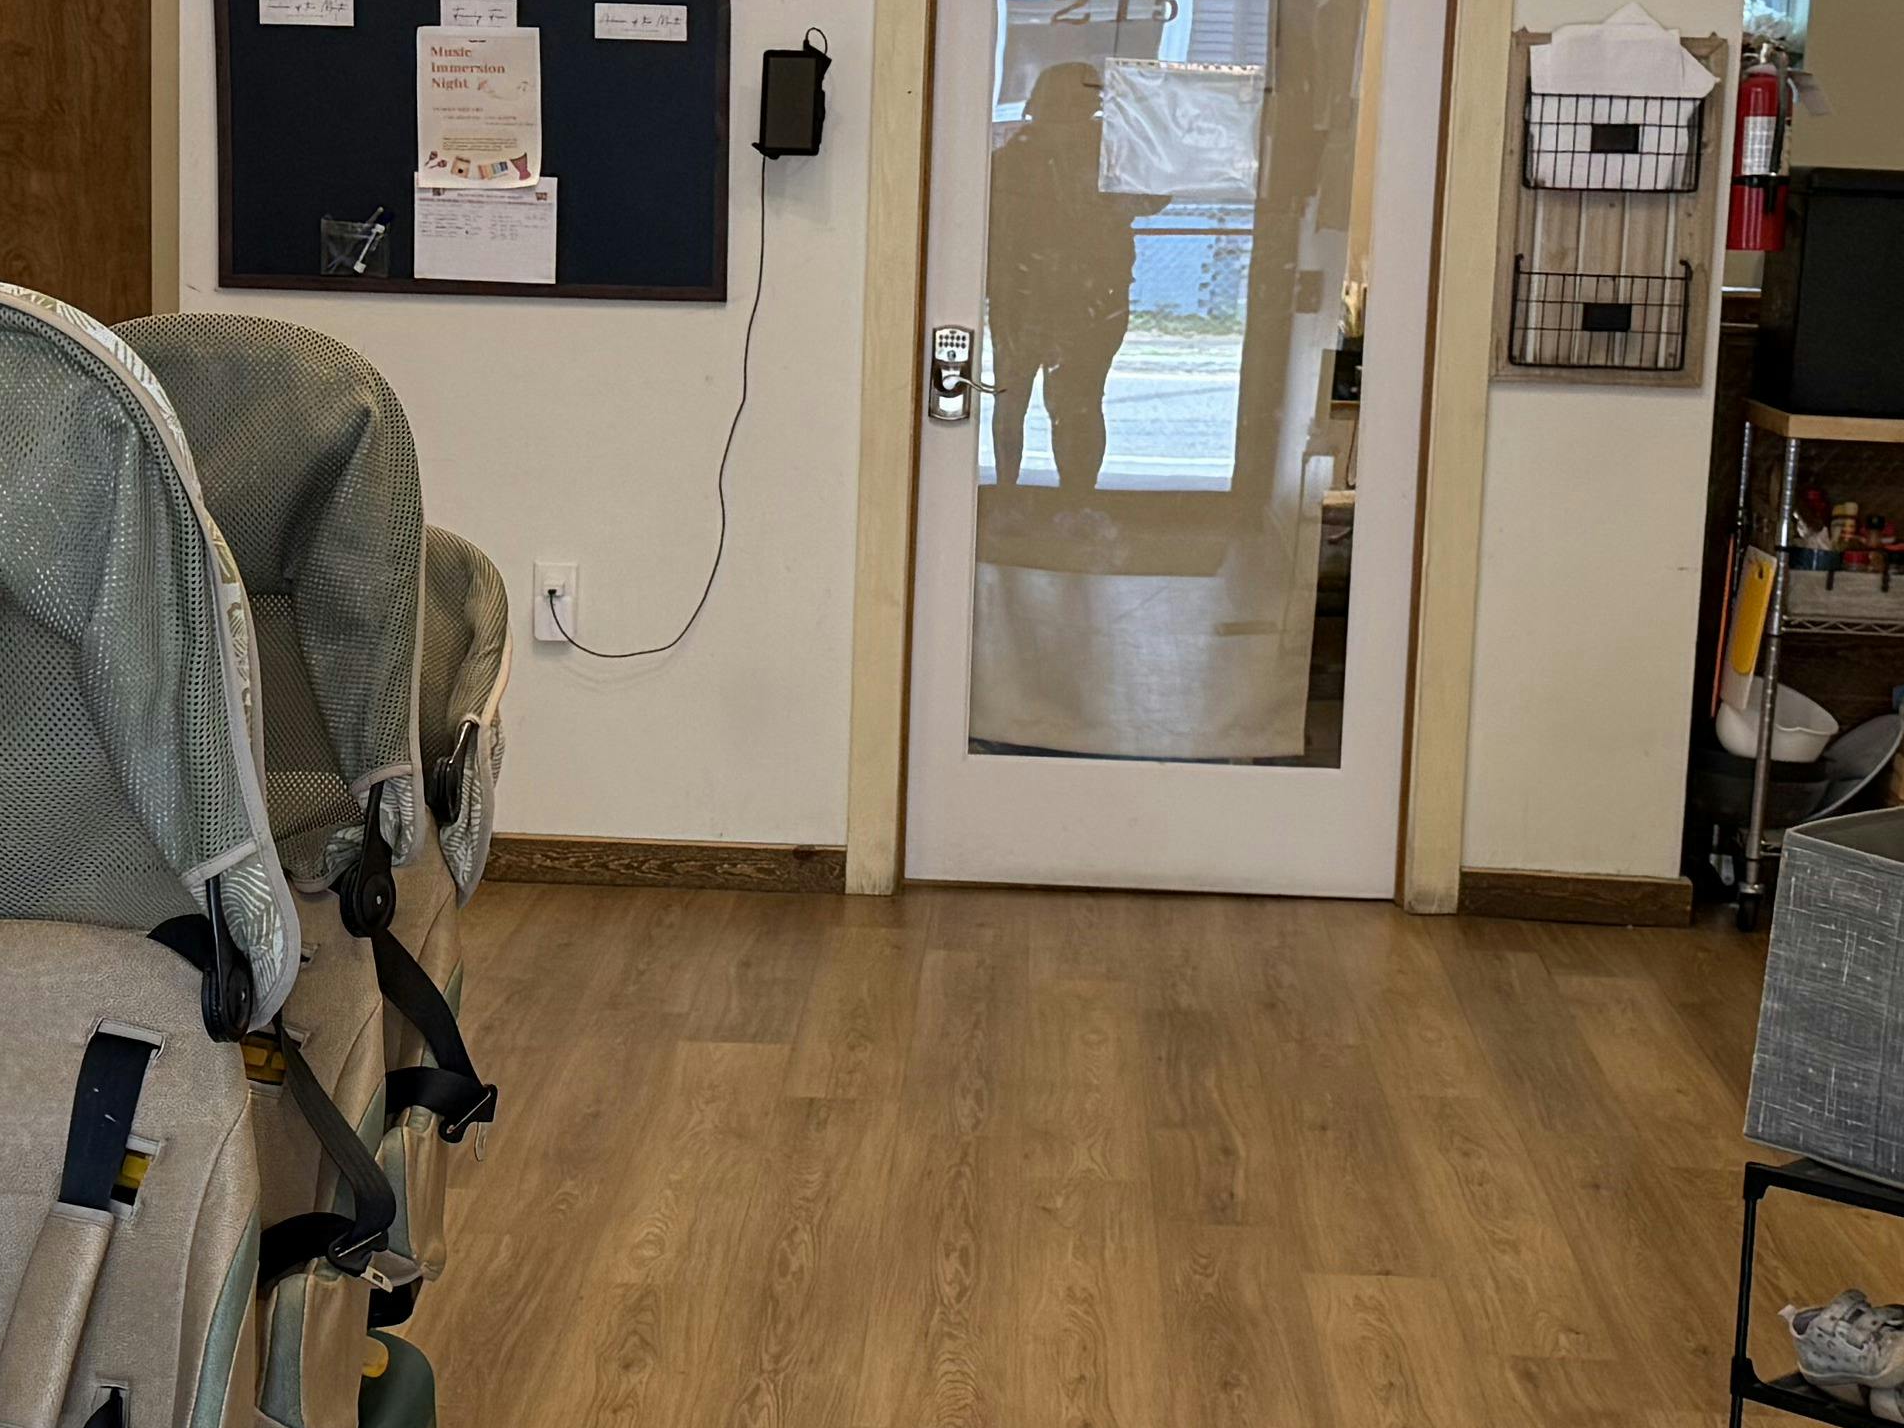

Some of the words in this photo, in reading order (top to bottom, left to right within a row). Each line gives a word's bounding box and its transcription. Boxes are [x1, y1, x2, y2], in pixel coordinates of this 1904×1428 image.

[431, 46, 472, 58] Music
[431, 62, 505, 74] Immersion
[432, 77, 470, 90] Night
